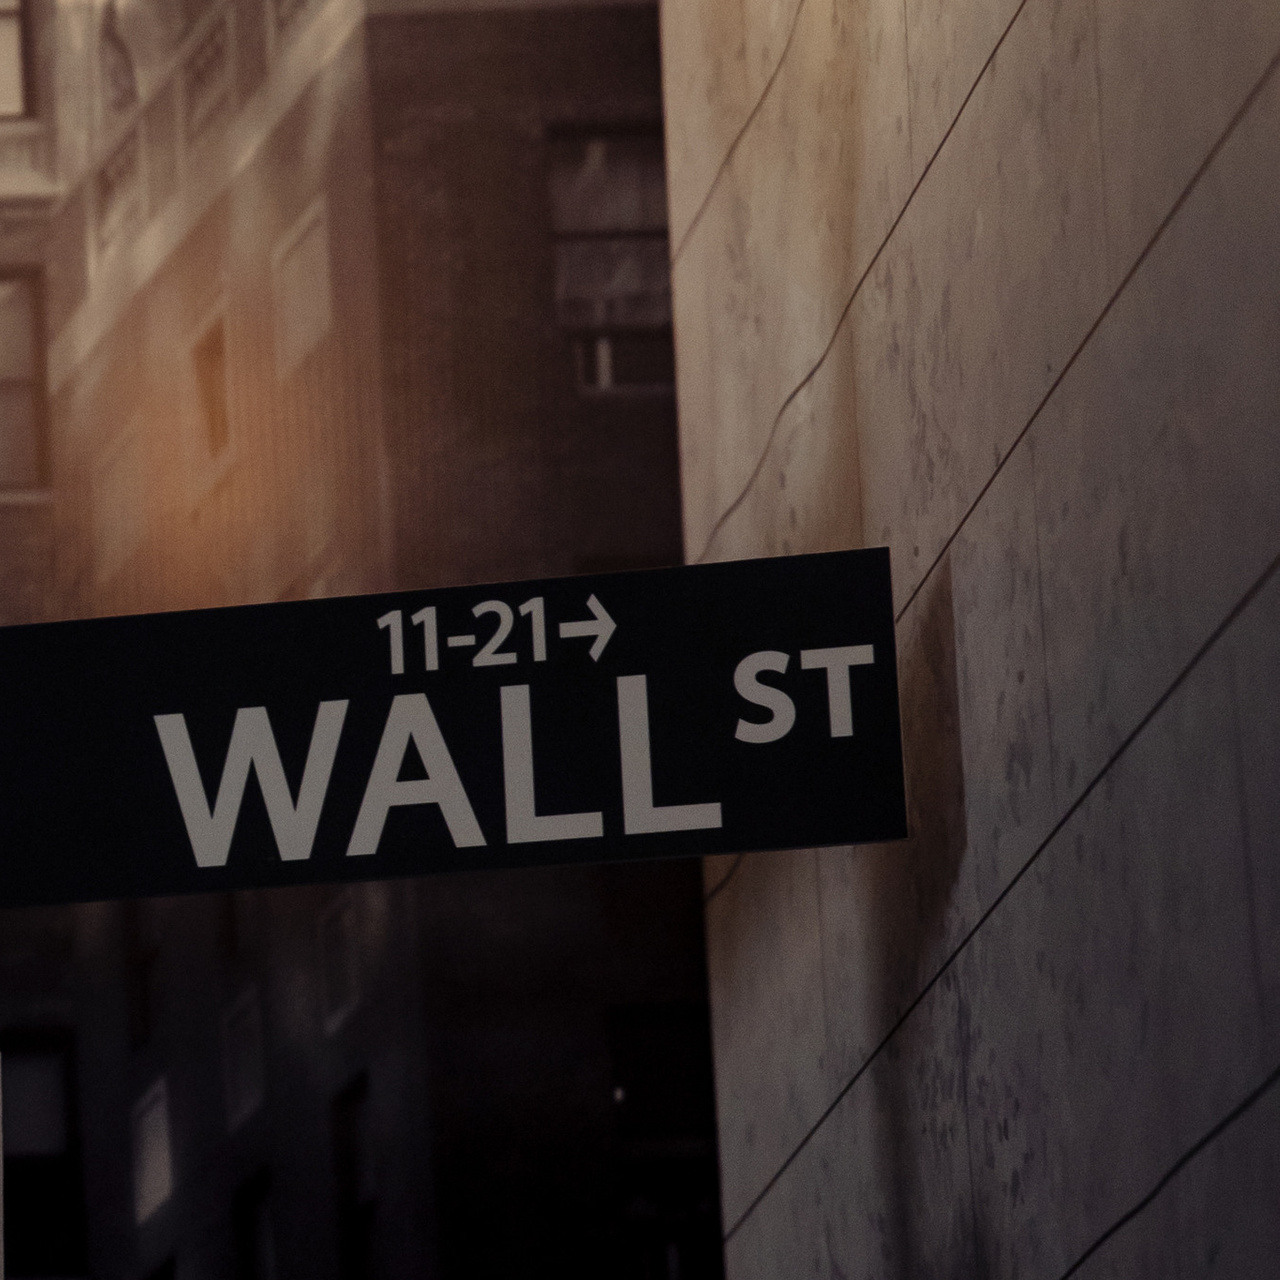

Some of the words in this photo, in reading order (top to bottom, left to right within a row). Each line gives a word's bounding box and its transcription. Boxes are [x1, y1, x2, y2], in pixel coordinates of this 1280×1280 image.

[376, 597, 547, 675] 11-21
[153, 675, 722, 868] WALL
[733, 644, 875, 744] ST
